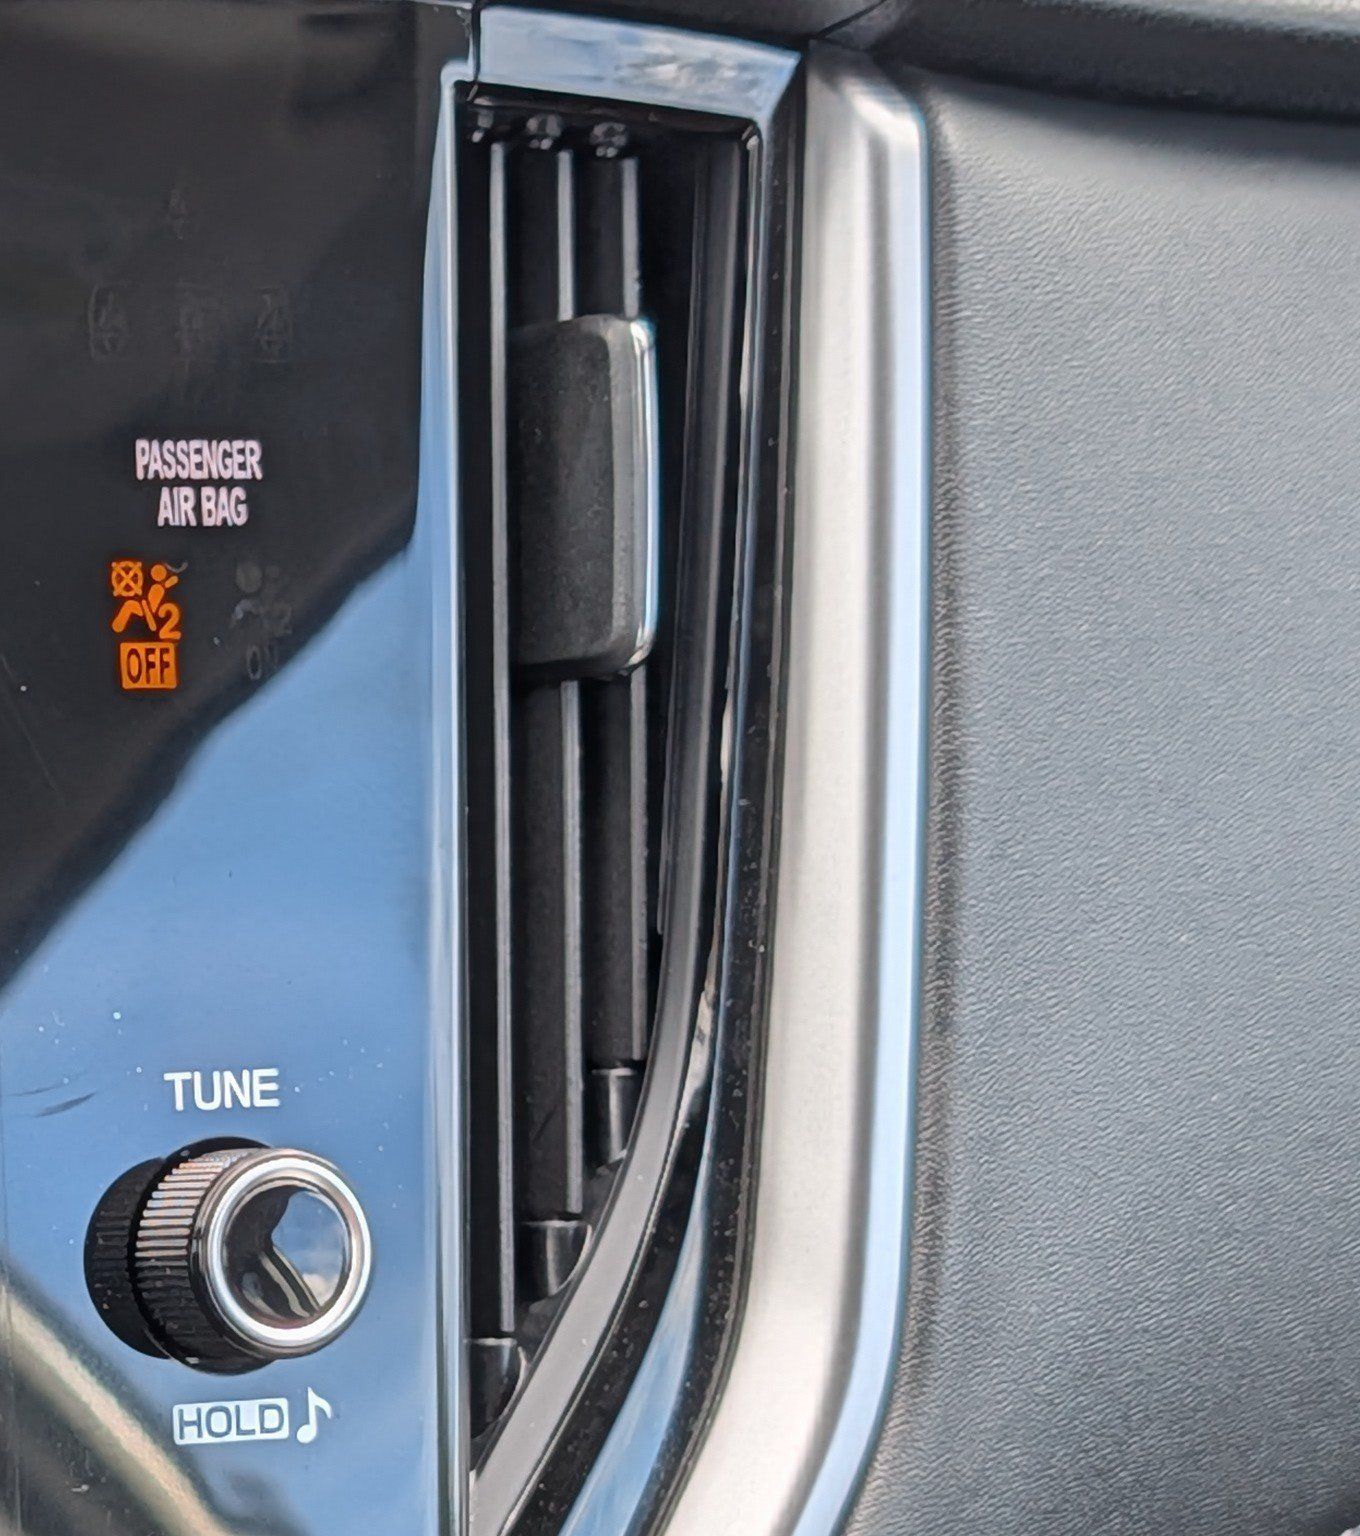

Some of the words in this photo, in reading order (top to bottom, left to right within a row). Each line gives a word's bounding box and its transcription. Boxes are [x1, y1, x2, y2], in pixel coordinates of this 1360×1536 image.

[135, 439, 263, 480] PASSENGER
[157, 486, 197, 527] AIR
[200, 486, 248, 527] BAG
[125, 647, 172, 684] OFF
[163, 1068, 280, 1111] TUNE
[178, 1403, 284, 1439] HOLD
